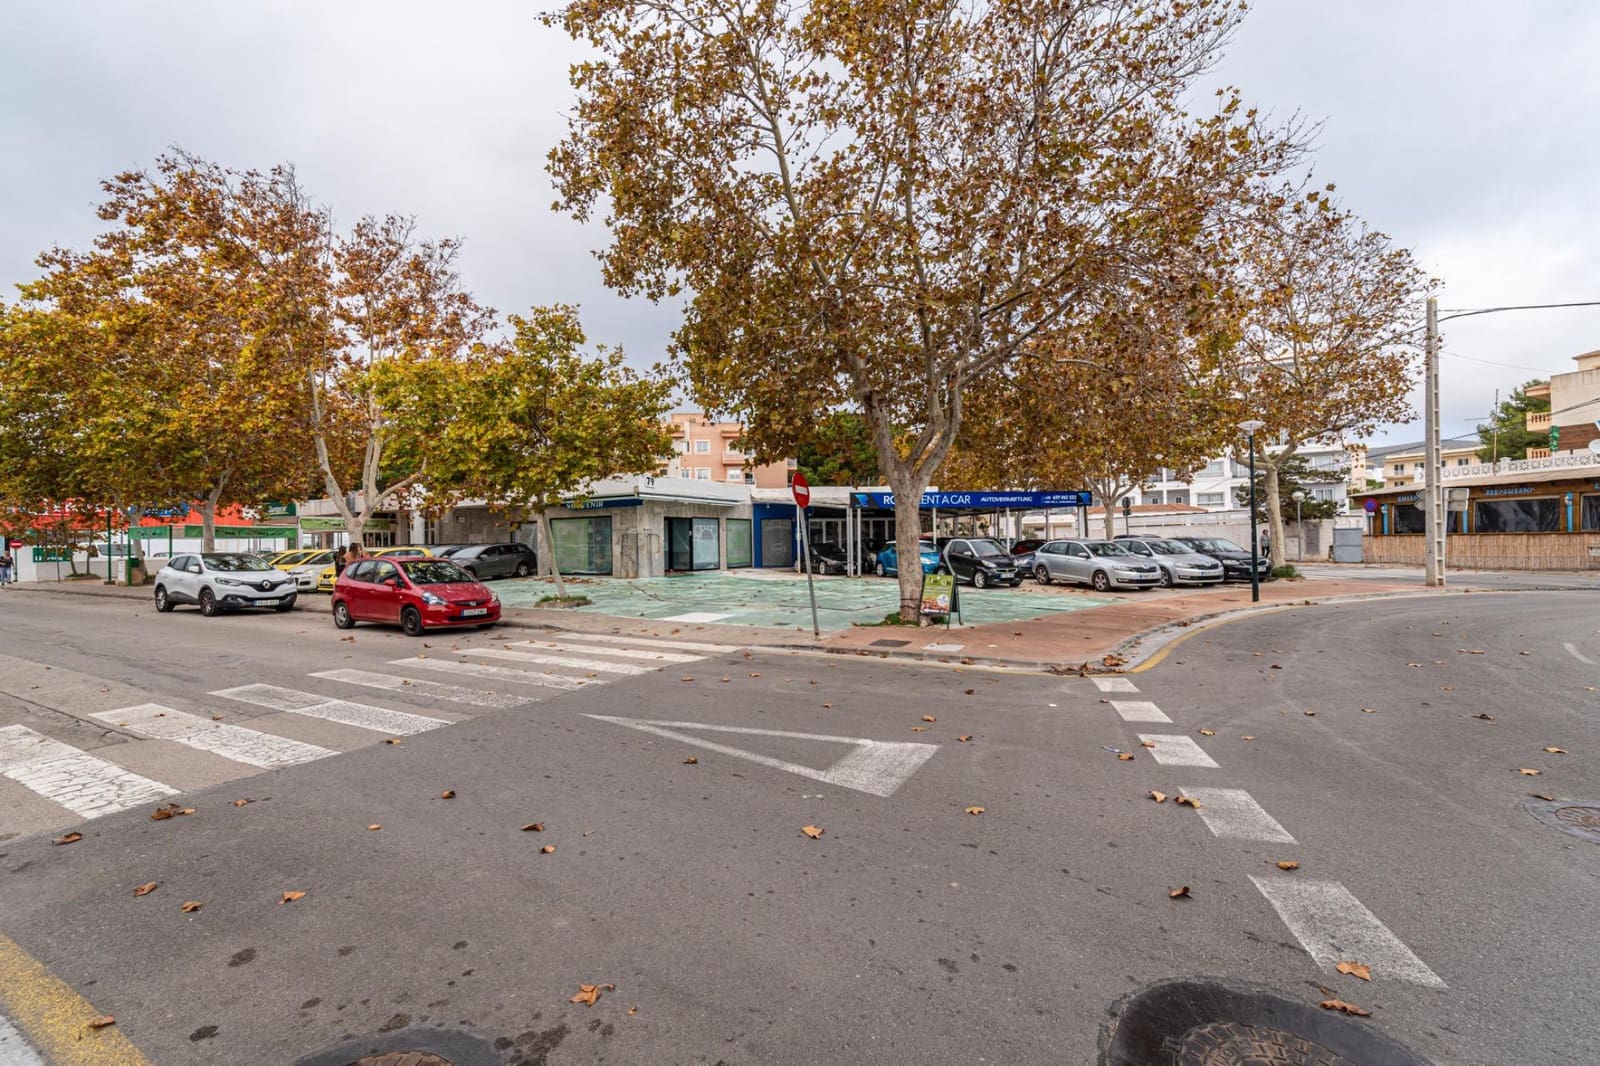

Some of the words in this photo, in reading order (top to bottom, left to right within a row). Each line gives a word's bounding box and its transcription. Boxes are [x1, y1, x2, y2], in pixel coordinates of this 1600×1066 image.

[646, 477, 655, 486] 79
[919, 495, 941, 505] ENT
[942, 495, 950, 505] A
[950, 495, 971, 505] CAR
